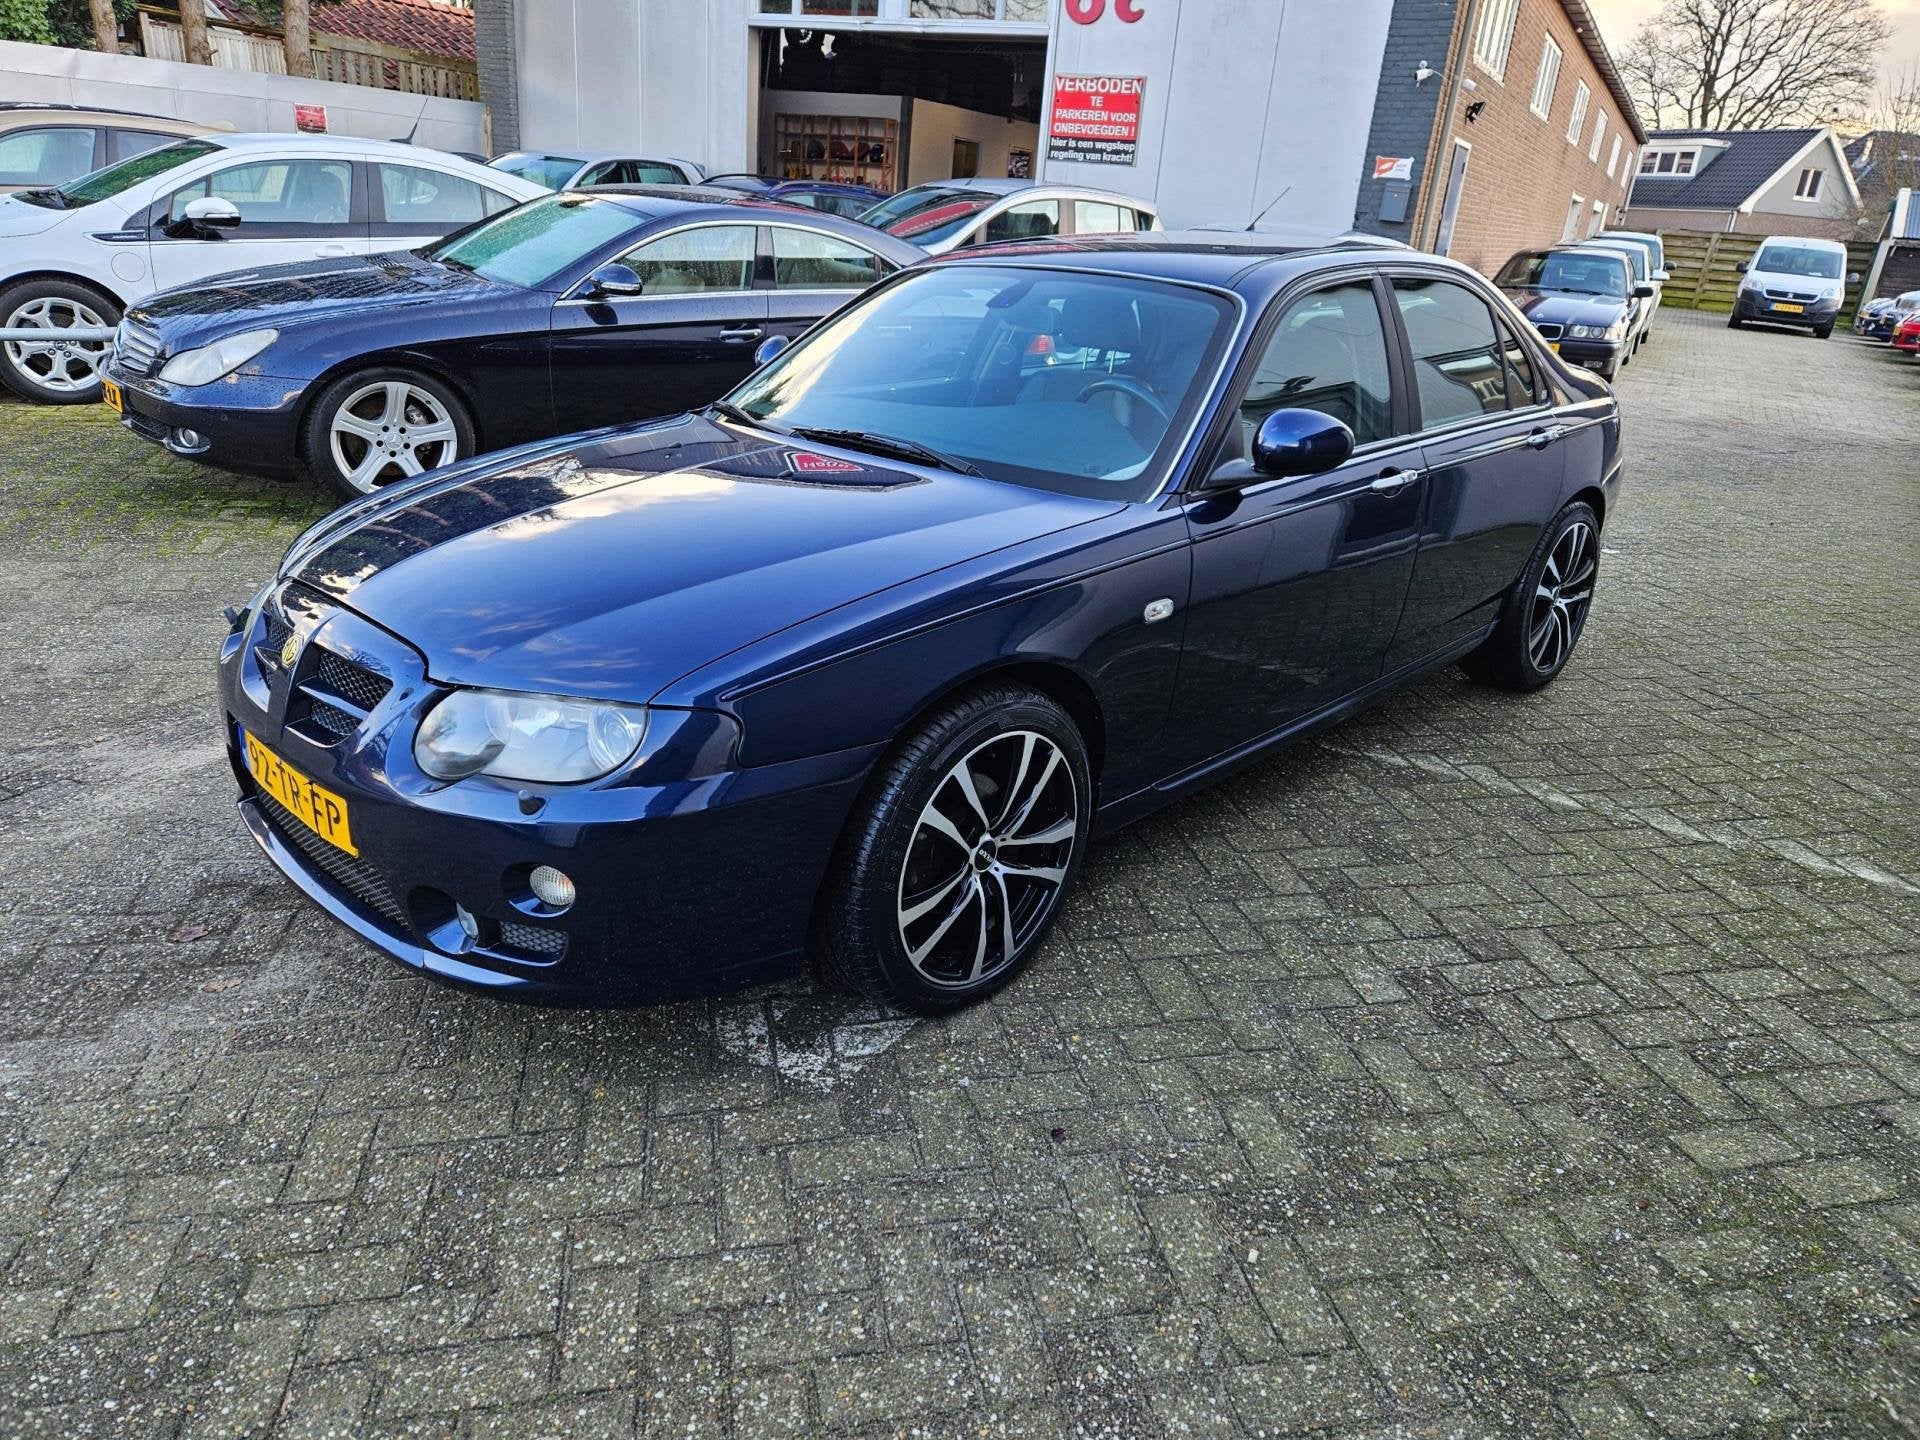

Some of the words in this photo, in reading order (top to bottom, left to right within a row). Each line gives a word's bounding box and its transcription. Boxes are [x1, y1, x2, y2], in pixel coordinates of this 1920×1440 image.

[1055, 77, 1144, 94] VERBODEN
[1090, 96, 1104, 107] TE
[1055, 108, 1108, 122] PARKEREN
[1110, 112, 1136, 123] VOOR
[1054, 122, 1128, 136] ONBEVOEGDEN
[1051, 137, 1067, 147] hier
[1068, 138, 1077, 147] is
[1077, 140, 1093, 148] een
[1095, 140, 1136, 152] wegsleep
[1051, 150, 1084, 161] regeling
[1085, 152, 1101, 161] van
[1102, 152, 1133, 162] kracht!
[249, 740, 341, 836] 92-TR-FP
